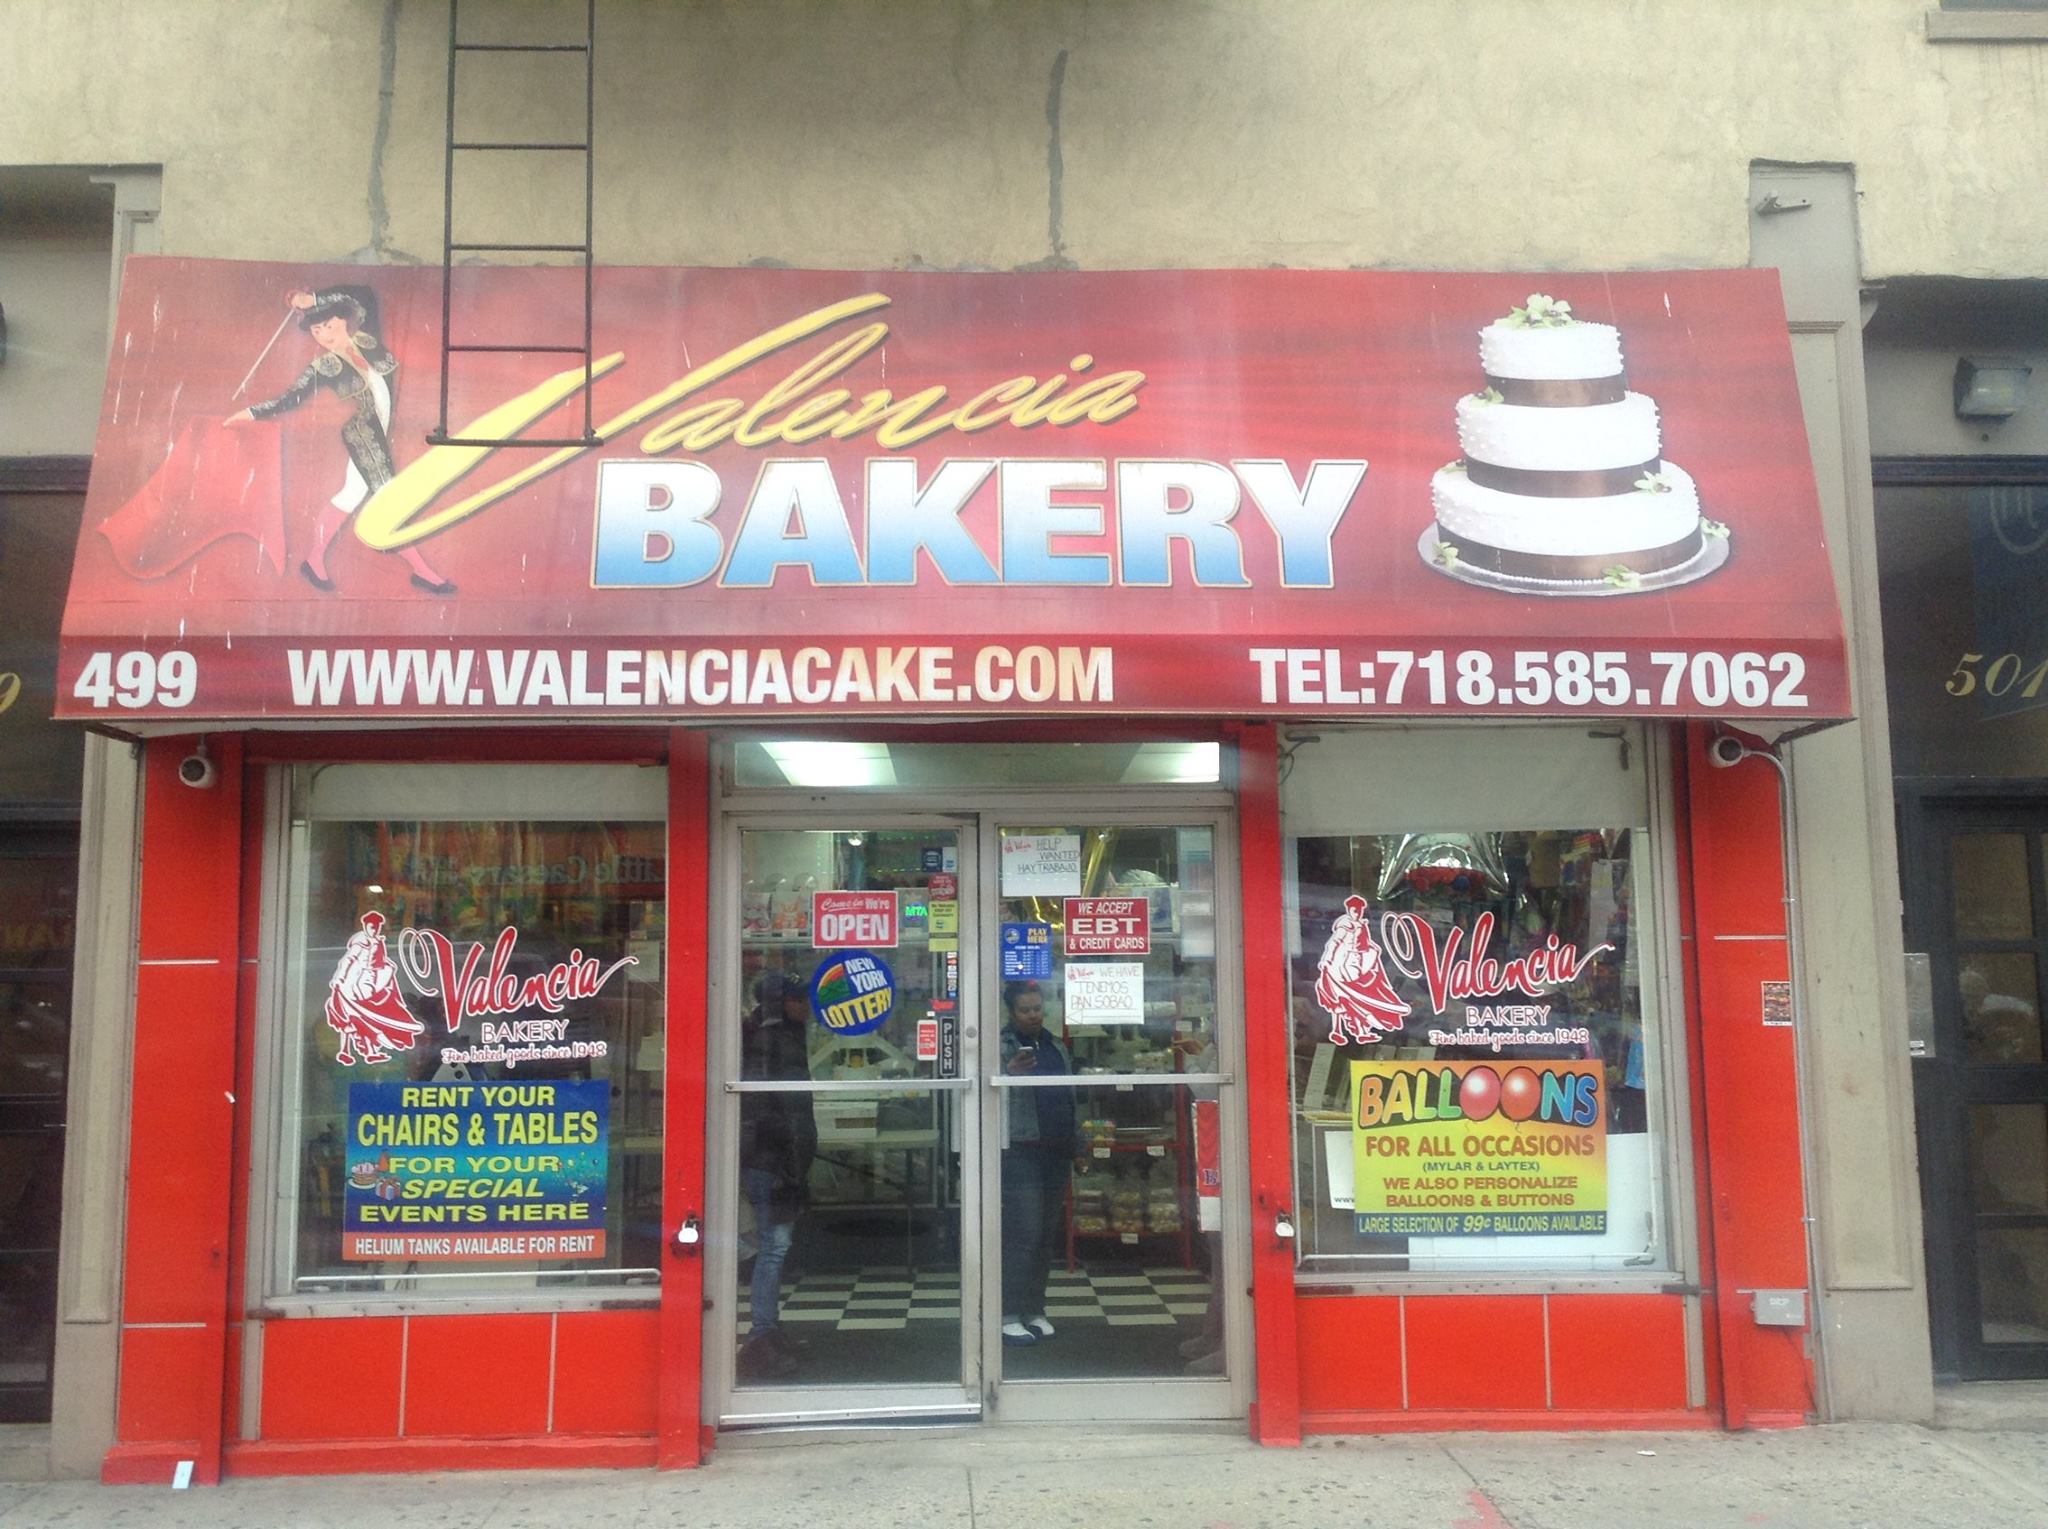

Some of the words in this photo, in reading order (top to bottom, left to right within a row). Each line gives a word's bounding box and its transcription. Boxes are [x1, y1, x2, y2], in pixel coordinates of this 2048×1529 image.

[354, 293, 1147, 550] Valencia
[591, 457, 1369, 591] BAKERY
[74, 651, 198, 707] 499
[286, 648, 1115, 706] WWW.VALENCIACAKE.COM
[1249, 648, 1809, 709] TEL:718.585.7062
[1036, 838, 1061, 850] HELP
[1040, 851, 1080, 861] WANTED
[821, 898, 852, 911] Come
[853, 898, 863, 907] in
[865, 898, 890, 909] We're
[1078, 902, 1093, 914] WE
[1095, 902, 1134, 914] ACCEPT
[821, 913, 890, 942] OPEN
[1072, 918, 1141, 935] EBT
[1069, 938, 1076, 950] &
[1079, 938, 1111, 950] CREDIT
[1113, 937, 1144, 949] CARDS
[844, 957, 876, 975] NEW
[1100, 966, 1115, 977] WE
[1116, 965, 1140, 977] HAVE
[1381, 911, 1615, 1015] Valencia
[398, 926, 639, 1032] Valencia
[850, 970, 887, 994] YORK
[1075, 981, 1128, 994] TENEMOS
[821, 986, 892, 1028] LOTTERY
[1466, 1005, 1551, 1027] BAKERY
[481, 1019, 569, 1044] BAKERY
[1428, 1030, 1455, 1046] Fine
[1456, 1028, 1490, 1045] baked
[1491, 1028, 1525, 1052] goods
[1526, 1031, 1554, 1044] since
[1555, 1028, 1589, 1044] 1948
[441, 1047, 470, 1064] Fine
[470, 1045, 504, 1063] baked
[505, 1043, 541, 1069] goods
[542, 1046, 571, 1060] since
[572, 1041, 607, 1058] 1948
[943, 1022, 953, 1070] PUSH
[402, 1087, 474, 1108] RENT
[481, 1086, 555, 1107] YOUR
[357, 1113, 459, 1146] CHAIRS
[467, 1113, 485, 1146] &
[494, 1111, 598, 1145] TABLES
[1366, 1136, 1410, 1157] FOR
[1417, 1136, 1456, 1157] ALL
[1462, 1135, 1595, 1157] OCCASIONS
[388, 1157, 455, 1174] FOR
[466, 1156, 560, 1173] YOUR
[1423, 1161, 1472, 1173] (MYLAR
[1476, 1162, 1484, 1171] &
[1488, 1161, 1540, 1173] LAYTEX)
[402, 1178, 545, 1199] SPECIAL
[1384, 1177, 1410, 1190] WE
[1414, 1177, 1459, 1190] ALSO
[1464, 1176, 1578, 1190] PERSONALIZE
[1386, 1194, 1475, 1207] BALLOONS
[1480, 1194, 1492, 1207] &
[1496, 1193, 1575, 1207] BUTTONS
[360, 1205, 488, 1223] EVENTS
[498, 1203, 590, 1222] HERE
[1359, 1217, 1390, 1233] LARGE
[1392, 1217, 1445, 1232] SELECTION
[1447, 1217, 1459, 1232] OF
[1493, 1216, 1548, 1232] BALLOONS
[1551, 1214, 1604, 1231] AVAILABLE
[355, 1238, 404, 1255] HELIUM
[408, 1238, 451, 1255] TANKS
[454, 1237, 525, 1254] AVAILABLE
[528, 1236, 555, 1253] FOR
[559, 1235, 595, 1252] RENT
